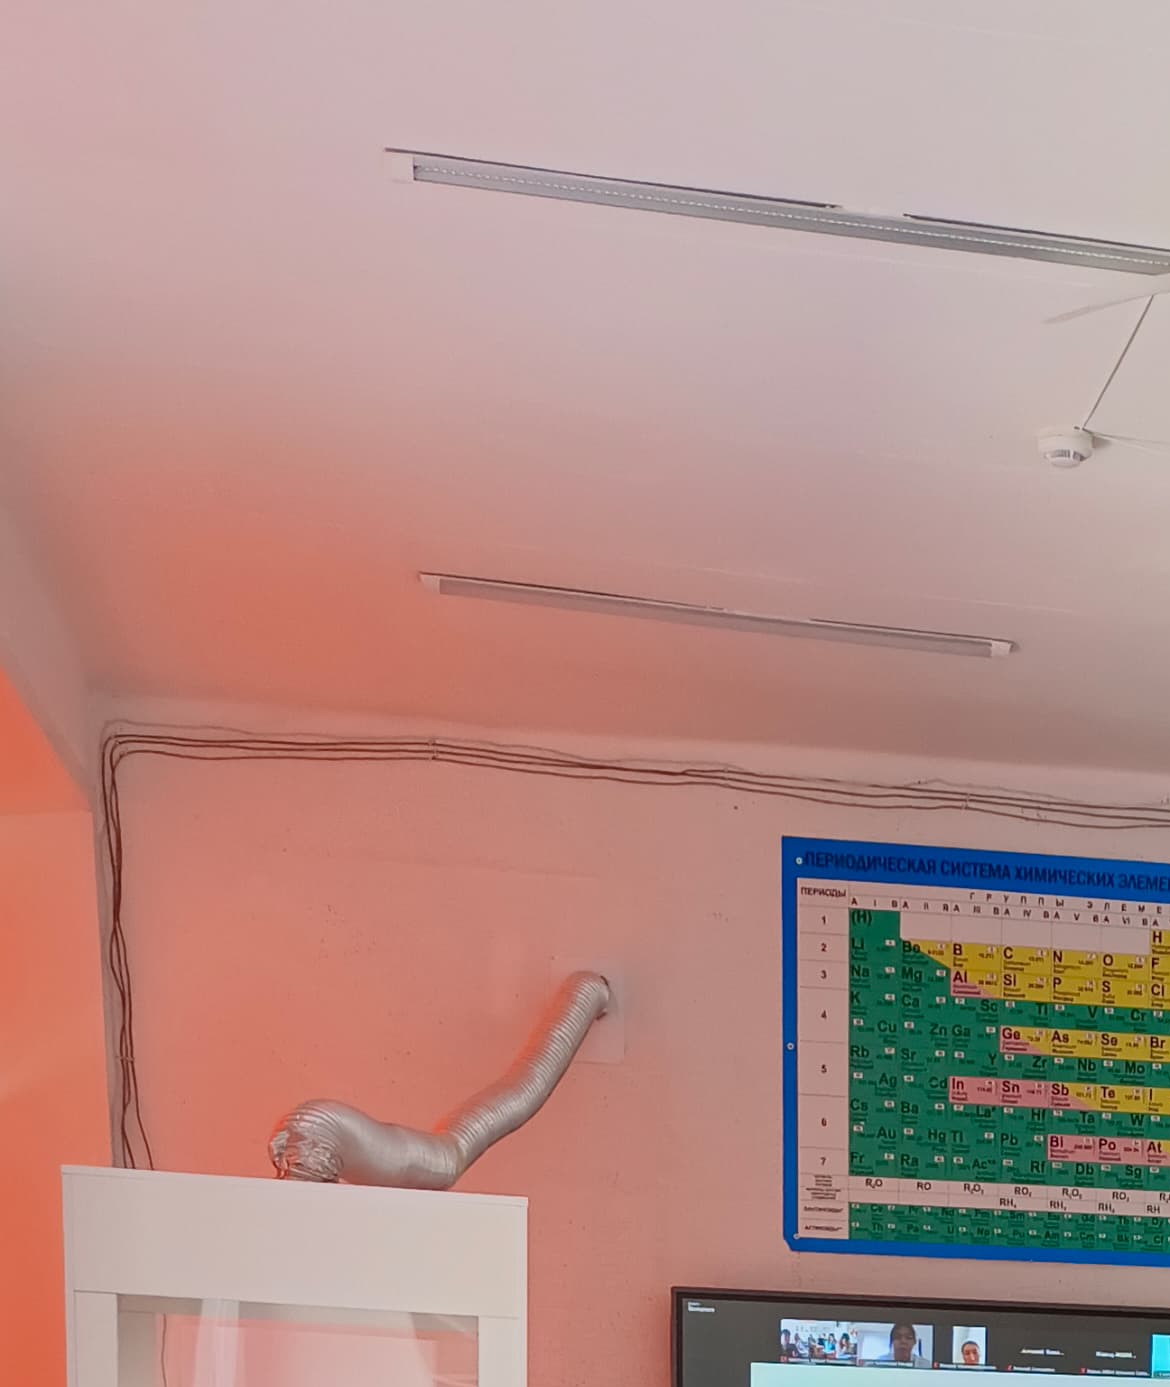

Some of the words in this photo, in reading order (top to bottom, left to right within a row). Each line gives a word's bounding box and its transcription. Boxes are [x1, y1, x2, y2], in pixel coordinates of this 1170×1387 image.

[805, 851, 936, 875] ПЕРИОДИЧЕСКАЯ
[940, 861, 1010, 879] СИСТЕМА
[1014, 864, 1114, 888] ХИМИЧЕСКИХ
[801, 886, 847, 898] ПЕРИОДЫ
[822, 916, 826, 924] 1
[851, 910, 872, 926] (H)
[1152, 931, 1162, 943] H
[821, 943, 827, 952] 2
[952, 943, 963, 955] B
[1003, 946, 1013, 959] C
[1053, 951, 1063, 962] N
[1102, 954, 1113, 966] O
[1151, 957, 1160, 970] F
[821, 969, 827, 979] 3
[851, 965, 870, 978] Na
[901, 968, 923, 983] Mg
[953, 971, 968, 982] Al
[1003, 974, 1016, 986] Si
[1053, 977, 1062, 989] P
[1102, 980, 1111, 994] S
[1151, 983, 1165, 996] Cl
[820, 1010, 828, 1019] 4
[850, 992, 860, 1004] K
[901, 995, 919, 1008] Ca
[1087, 1006, 1098, 1019] V
[1130, 1009, 1146, 1022] Cr
[877, 1020, 897, 1033] Cu
[929, 1023, 948, 1036] Zn
[951, 1024, 971, 1037] Ga
[1002, 1027, 1021, 1040] Ge
[1051, 1031, 1069, 1043] As
[1100, 1034, 1118, 1046] Se
[1150, 1036, 1166, 1049] Br
[821, 1065, 827, 1074] 5
[850, 1045, 870, 1058] Rb
[901, 1048, 917, 1061] Sr
[988, 1053, 997, 1065] Y
[1032, 1055, 1047, 1068] Zr
[1078, 1059, 1096, 1071] Nb
[1124, 1061, 1145, 1074] Mo
[878, 1073, 897, 1088] Ag
[928, 1076, 948, 1089] Cd
[952, 1078, 965, 1091] In
[1002, 1081, 1020, 1094] Sn
[1051, 1083, 1069, 1096] Sb
[1100, 1086, 1116, 1099] Te
[821, 1118, 827, 1127] 6
[850, 1099, 868, 1112] Cs
[901, 1101, 919, 1114] Ba
[1031, 1109, 1047, 1121] Hf
[1079, 1112, 1095, 1124] Ta
[1130, 1115, 1144, 1126] W
[876, 1126, 897, 1139] Au
[928, 1129, 946, 1144] Hg
[951, 1130, 964, 1143] Tl
[1000, 1133, 1018, 1146] Pb
[1049, 1136, 1064, 1148] Bi
[1098, 1139, 1116, 1151] Po
[1147, 1141, 1162, 1154] At
[820, 1157, 827, 1166] 7
[850, 1151, 864, 1164] Fr
[901, 1154, 919, 1167] Ra
[1030, 1160, 1045, 1173] Rf
[1075, 1164, 1094, 1176] Db
[1125, 1165, 1142, 1180] Sg
[917, 1181, 931, 1191] RO
[1147, 1204, 1160, 1213] RH
